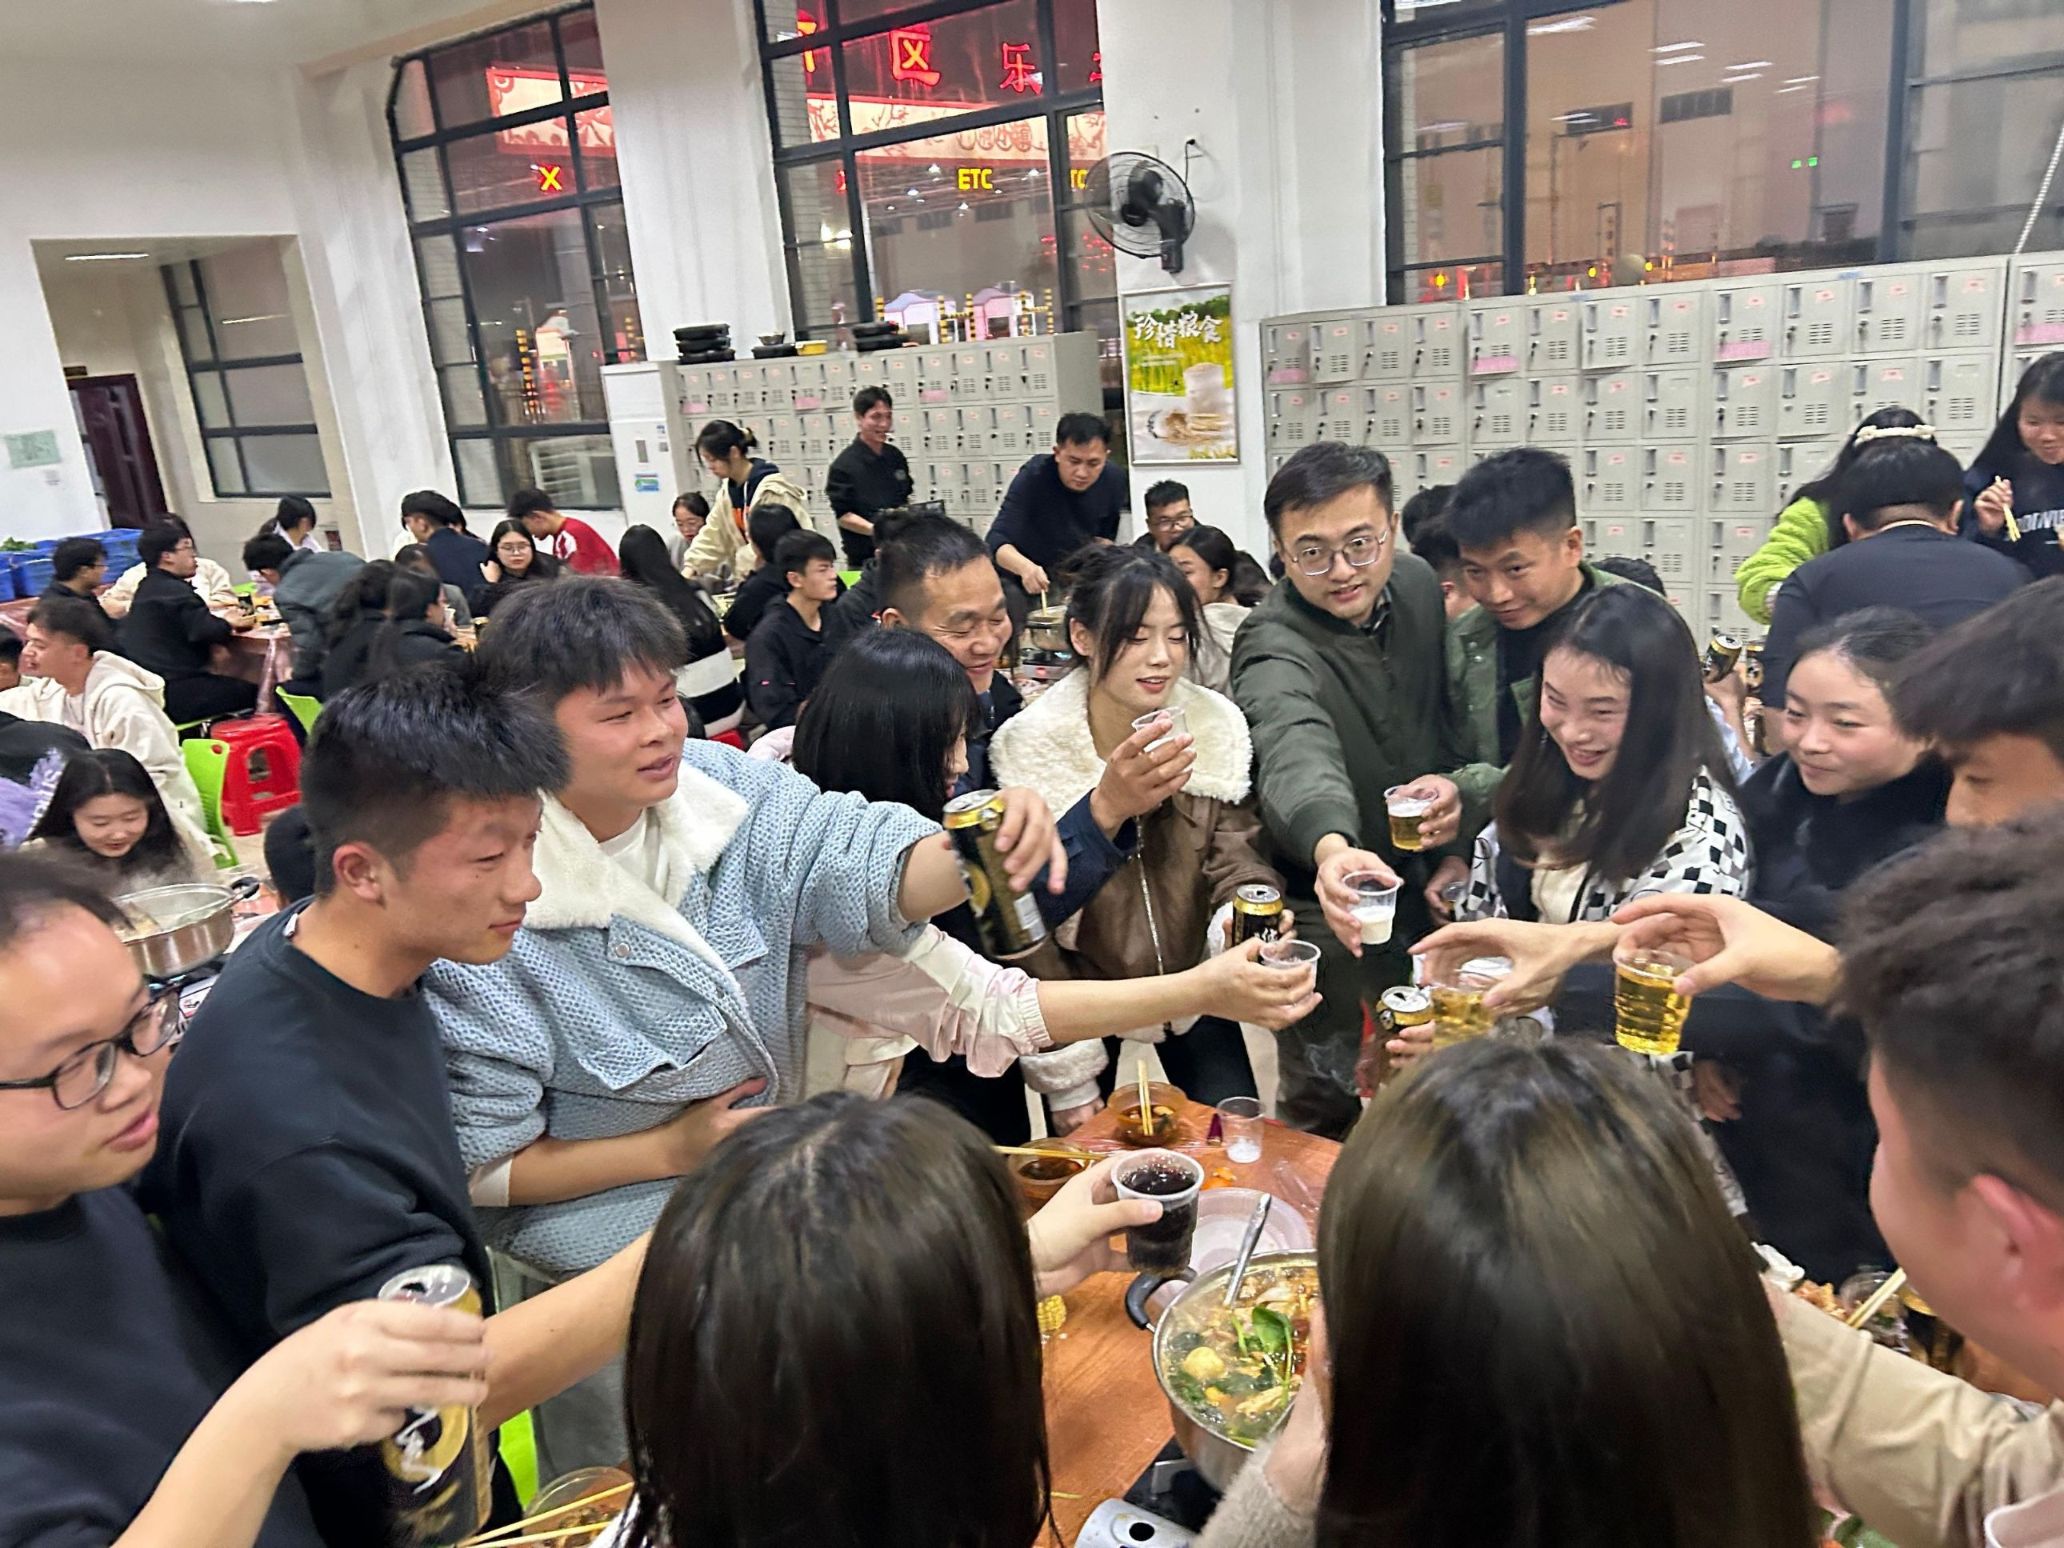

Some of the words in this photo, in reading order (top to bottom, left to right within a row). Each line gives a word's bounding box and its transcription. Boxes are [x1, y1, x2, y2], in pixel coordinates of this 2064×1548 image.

[958, 168, 993, 190] ETC
[1070, 169, 1089, 190] TC
[1134, 310, 1224, 349] 珍惜粮食
